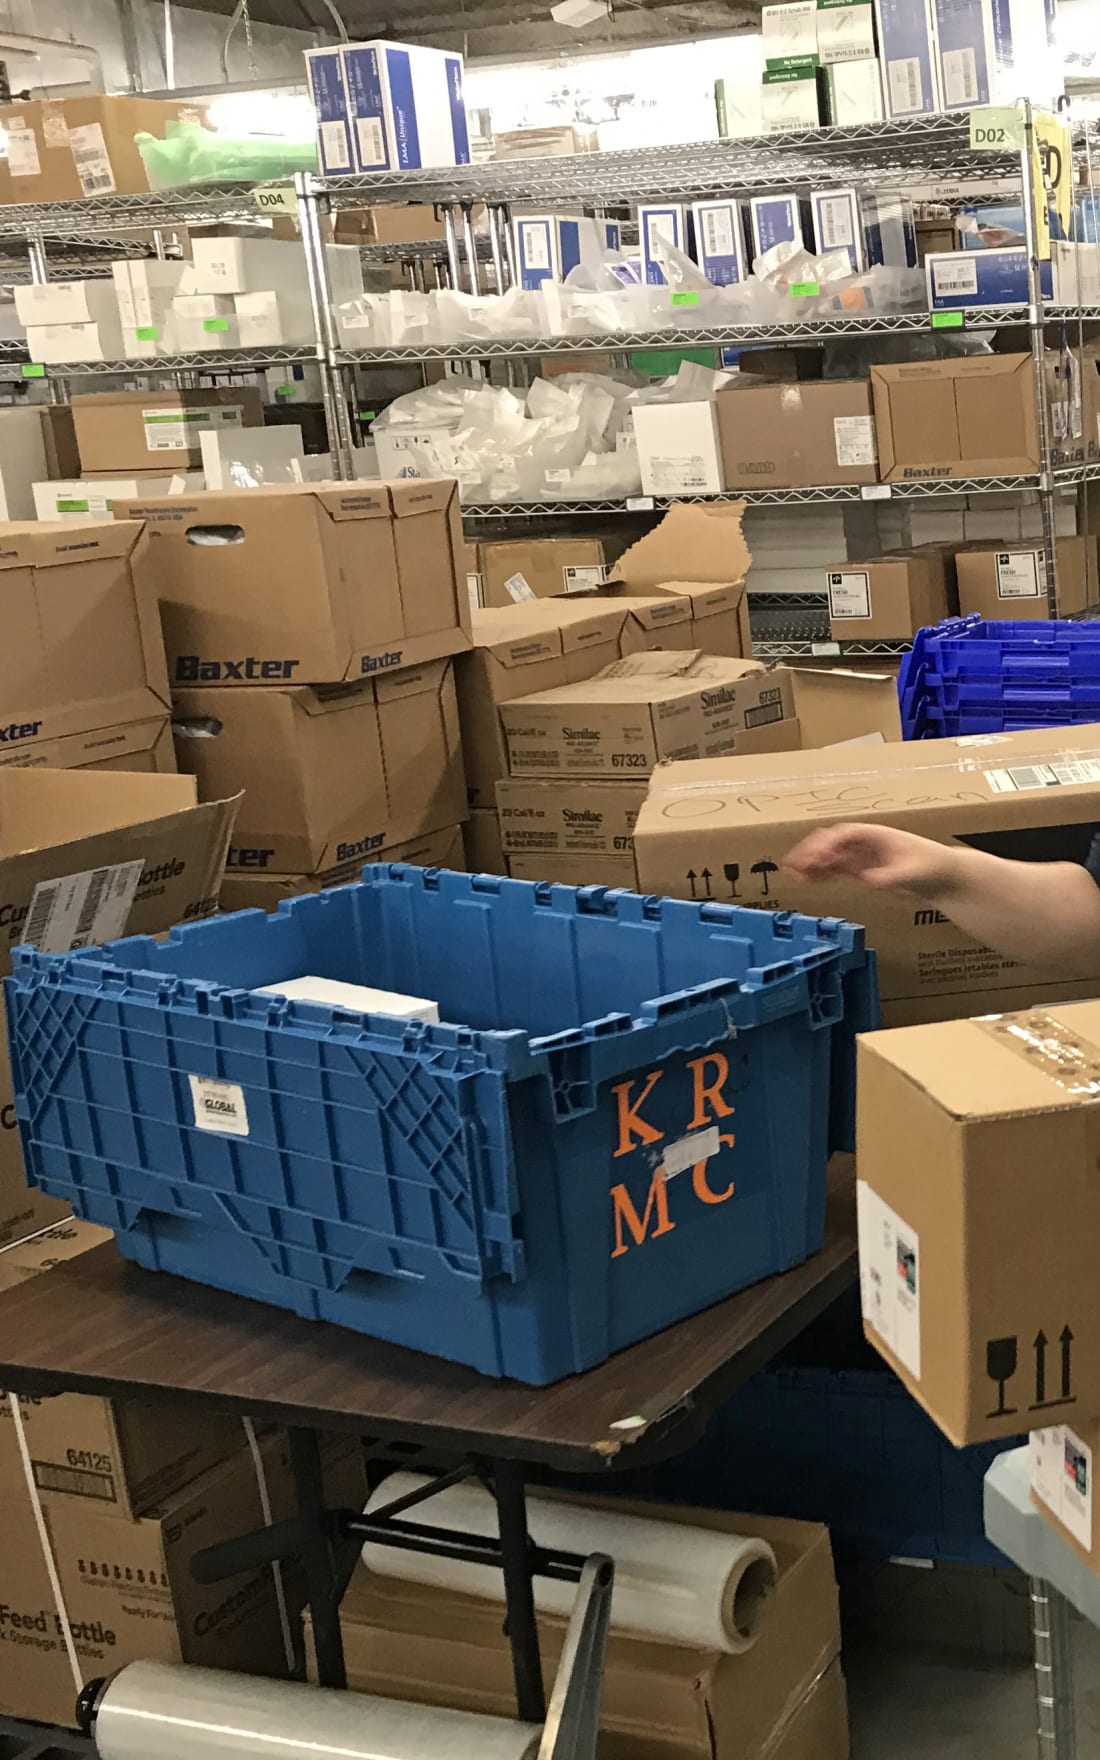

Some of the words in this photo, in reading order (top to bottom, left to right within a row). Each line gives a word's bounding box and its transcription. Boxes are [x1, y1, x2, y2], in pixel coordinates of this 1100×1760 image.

[975, 128, 1005, 143] D02
[259, 191, 285, 208] D04
[903, 467, 952, 478] Baxter
[175, 656, 300, 681] Baxter
[361, 650, 404, 674] Baxter
[700, 687, 736, 710] Similac
[758, 687, 782, 704] 67323
[0, 720, 43, 742] xter
[562, 727, 601, 740] Similac
[611, 753, 648, 768] 67323
[562, 808, 603, 822] Similac
[336, 832, 387, 861] Baxter
[613, 836, 634, 849] 673
[225, 849, 275, 868] ter
[138, 856, 186, 887] ottle
[918, 951, 946, 960] Sterile
[948, 945, 996, 957] Disposabl
[204, 1098, 237, 1113] GLOBAL
[66, 1448, 112, 1473] 64125
[61, 1640, 104, 1659] Bttles
